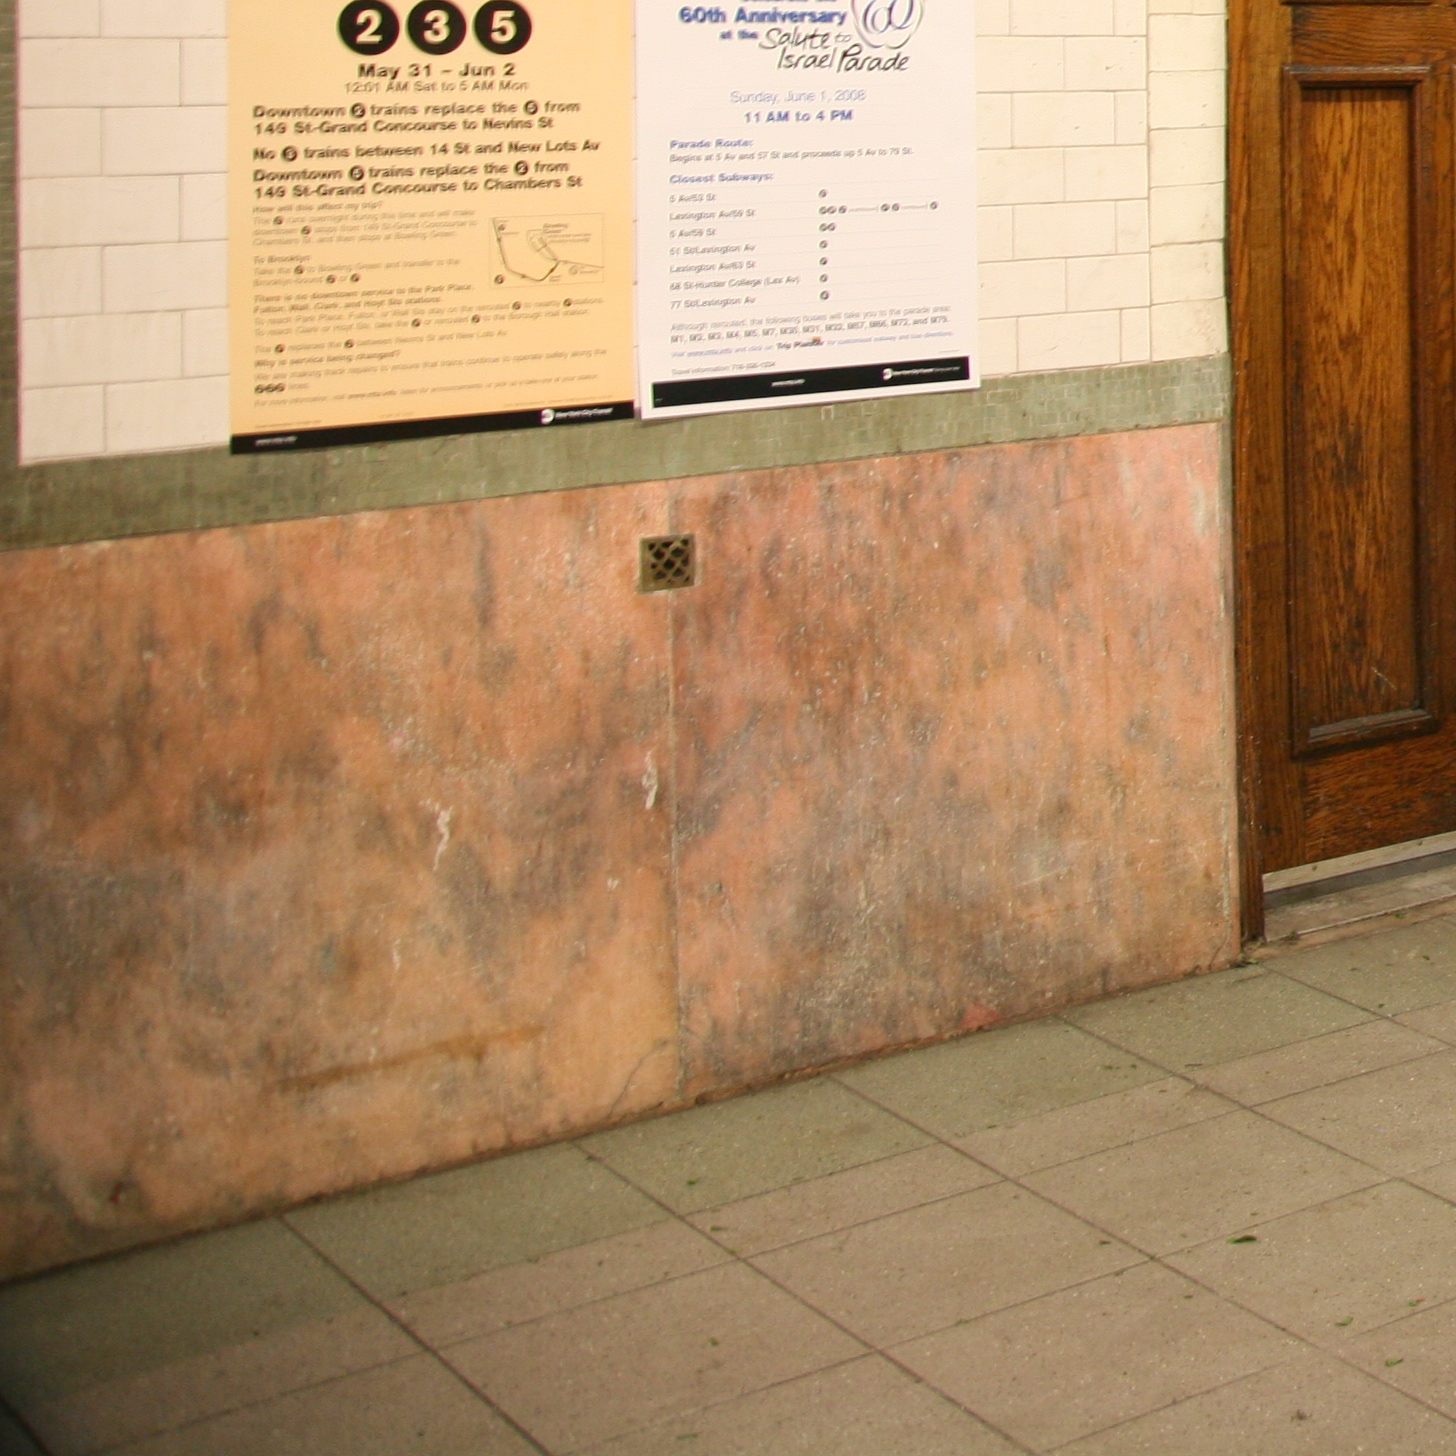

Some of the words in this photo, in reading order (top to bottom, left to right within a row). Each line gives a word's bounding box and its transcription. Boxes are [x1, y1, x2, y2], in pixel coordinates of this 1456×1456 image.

[355, 8, 383, 44] 2
[423, 9, 451, 44] 3
[490, 10, 517, 44] 5
[679, 7, 726, 23] 60th
[734, 7, 848, 26] Anniversary
[719, 30, 732, 40] at
[738, 30, 759, 40] the
[759, 26, 830, 50] Salute
[834, 32, 854, 43] to
[777, 48, 836, 70] Israel
[836, 43, 910, 73] Parade
[357, 63, 399, 79] May
[408, 63, 432, 77] 31
[459, 63, 495, 77] Jun
[503, 63, 515, 77] 2
[386, 80, 409, 93] AM
[414, 80, 436, 92] Sat
[441, 81, 456, 92] to
[472, 80, 495, 92] AM
[498, 80, 528, 92] Mon
[730, 90, 778, 105] Sunday,
[784, 90, 817, 102] June
[834, 89, 866, 102] 2008
[253, 104, 346, 119] Downtown
[370, 103, 418, 116] trains
[424, 102, 486, 116] replace
[491, 101, 518, 114] the
[544, 100, 581, 113] from
[744, 112, 759, 123] 11
[766, 111, 790, 123] AM
[795, 111, 811, 122] to
[816, 111, 825, 122] 4
[830, 110, 853, 121] PM
[293, 120, 368, 134] St-Grand
[373, 119, 457, 133] Concourse
[462, 118, 478, 131] to
[482, 117, 534, 130] Nevins
[538, 116, 554, 129] St
[253, 148, 275, 162] No
[304, 146, 351, 159] trains
[355, 143, 424, 157] between
[430, 143, 449, 156] 14
[453, 142, 471, 156] St
[474, 141, 502, 154] and
[508, 140, 541, 153] New
[546, 139, 577, 153] Lots
[582, 139, 600, 151] Av
[253, 168, 343, 182] Downtown
[368, 165, 415, 179] trains
[420, 164, 478, 179] replace
[484, 163, 508, 176] the
[534, 161, 570, 175] from
[670, 174, 715, 184] Closest
[292, 183, 366, 198] St-Grand
[372, 181, 459, 196] Concourse
[463, 180, 479, 192] to
[484, 178, 562, 192] Chambers
[566, 176, 584, 189] St
